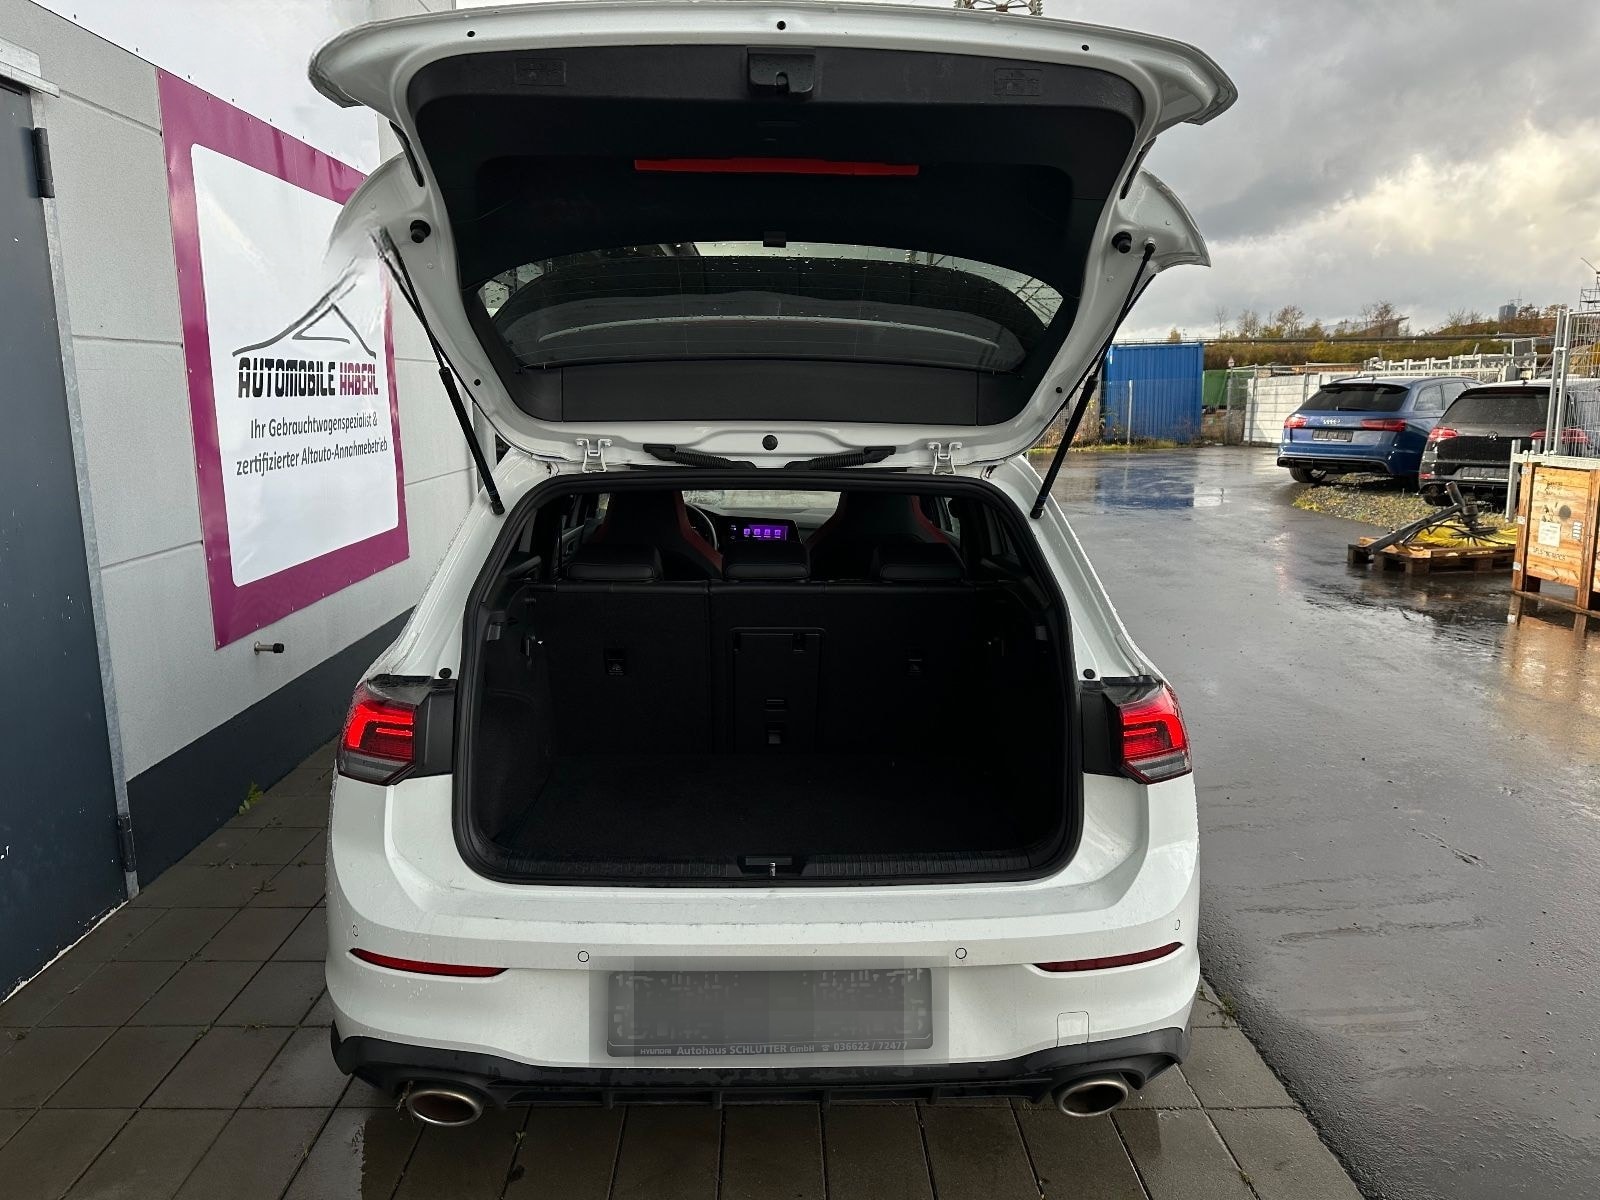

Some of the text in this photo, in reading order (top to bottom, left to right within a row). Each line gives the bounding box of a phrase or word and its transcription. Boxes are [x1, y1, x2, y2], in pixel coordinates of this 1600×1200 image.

[238, 357, 379, 398] AUTOMOBILE HABERL
[250, 411, 378, 439] Ihr Gebrauchtwagenspezialist &
[236, 436, 388, 477] zertifizierter Altauto-Annahmebetrieb
[677, 1045, 727, 1055] Autohaus
[789, 1043, 815, 1053] GmbH
[833, 1041, 870, 1051] 036622
[877, 1040, 908, 1050] 72477
